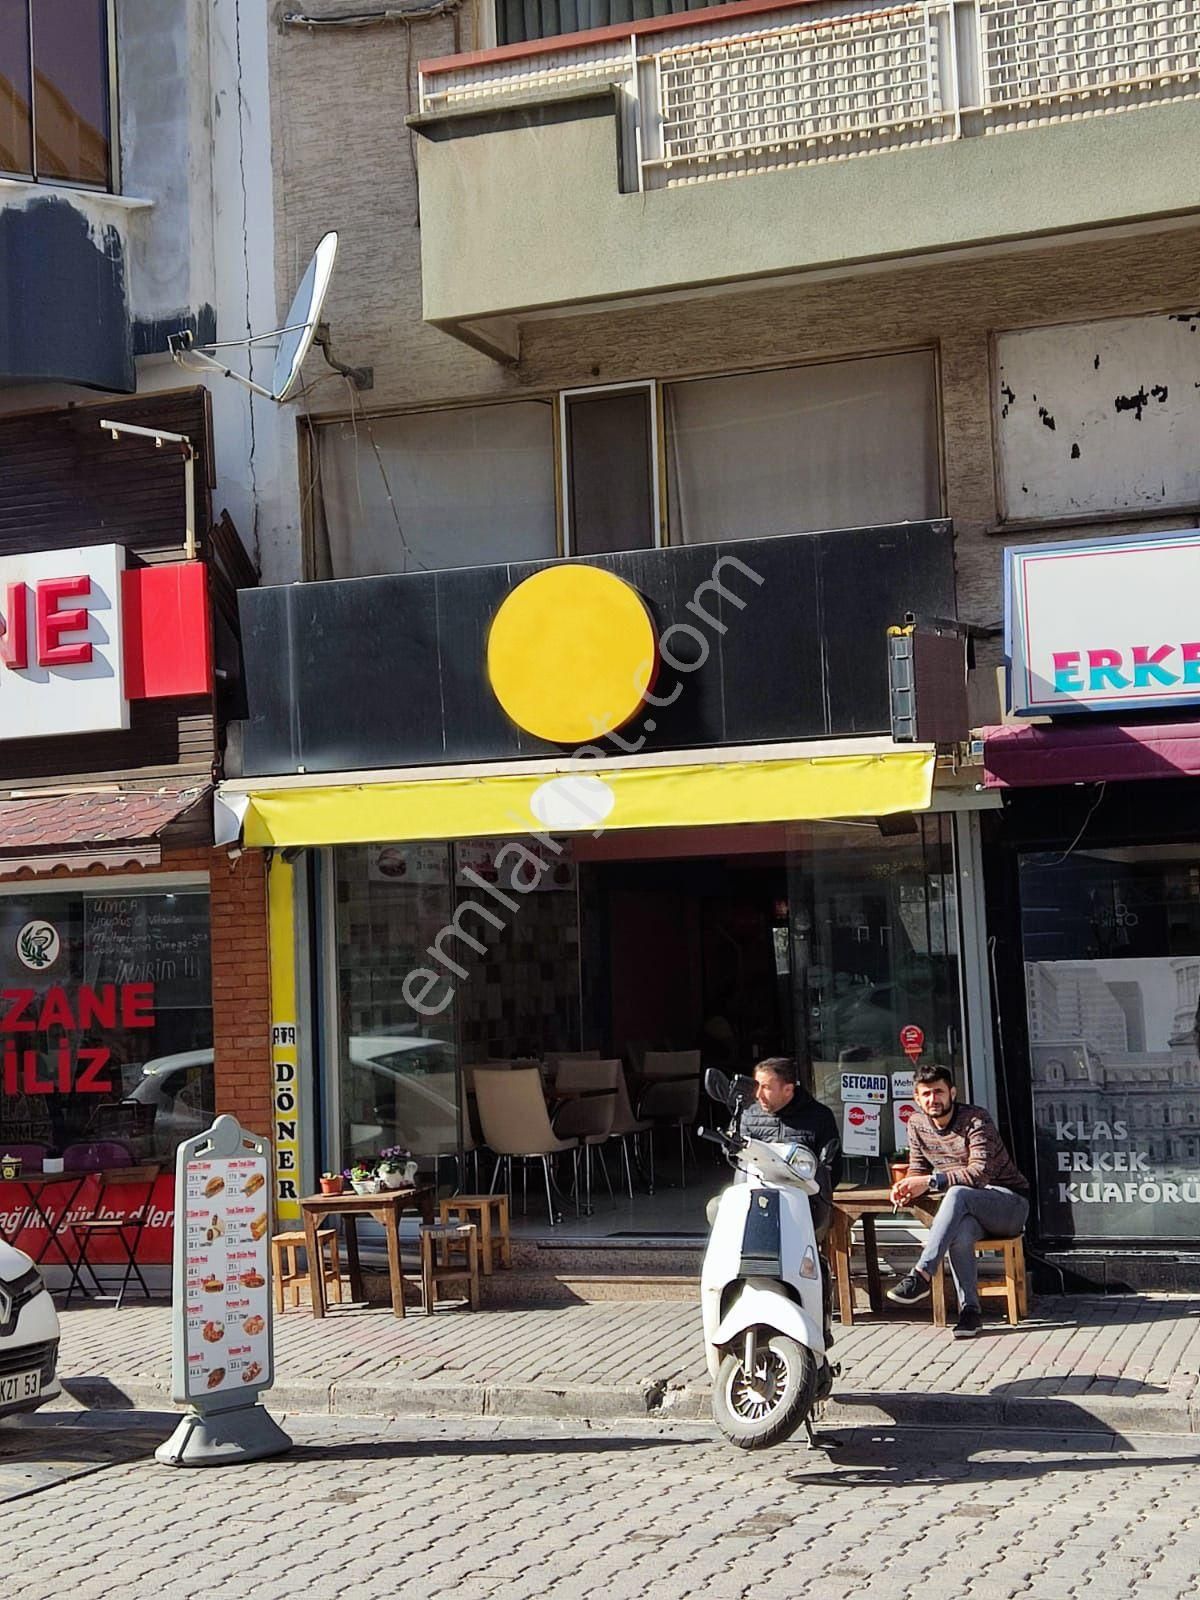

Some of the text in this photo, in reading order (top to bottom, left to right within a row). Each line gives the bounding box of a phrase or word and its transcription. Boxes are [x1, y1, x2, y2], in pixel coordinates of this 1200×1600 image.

[0, 982, 156, 1032] ZANE
[4, 1038, 112, 1096] İLİZ
[842, 1075, 887, 1091] SETCARD
[893, 1079, 915, 1088] Metr
[275, 1063, 298, 1199] DÖNER
[1056, 1120, 1128, 1141] KLAS
[1058, 1152, 1150, 1172] ERKEK
[1059, 1177, 1200, 1204] KUAFÖRÜ
[24, 1373, 37, 1396] 53
